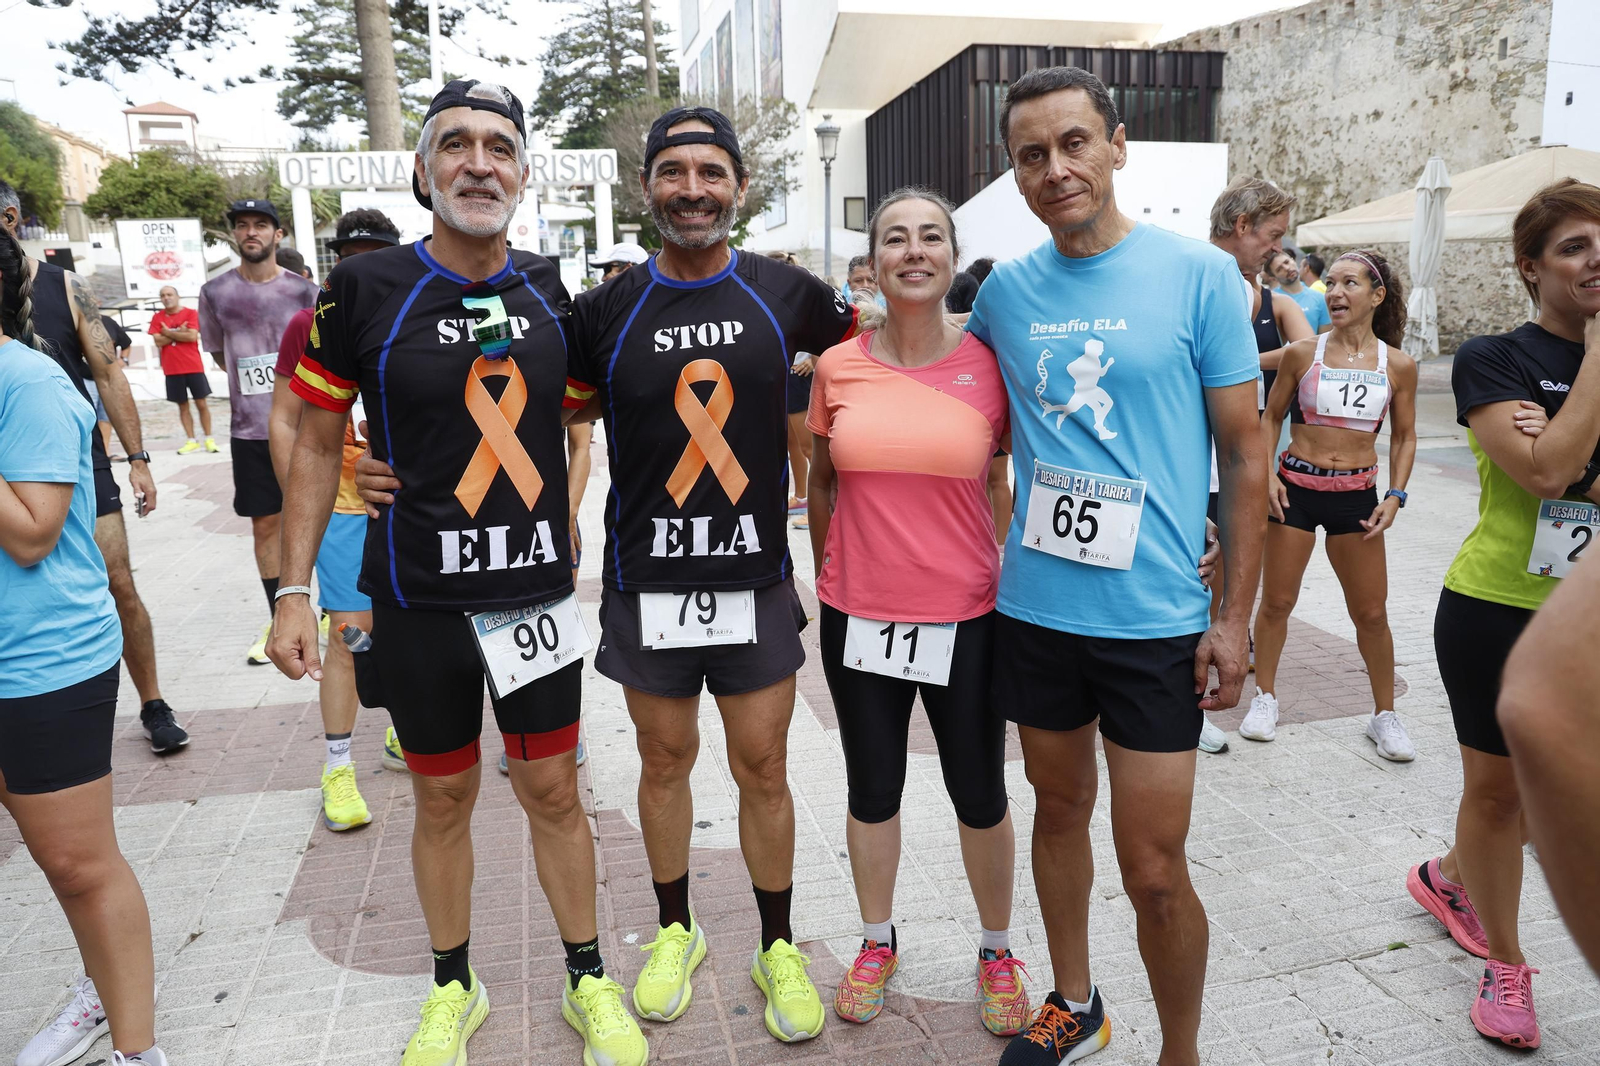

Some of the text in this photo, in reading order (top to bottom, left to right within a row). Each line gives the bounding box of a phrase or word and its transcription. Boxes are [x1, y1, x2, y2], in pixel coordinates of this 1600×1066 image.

[285, 153, 615, 186] OFICINA RISMO
[142, 222, 175, 235] OPEN
[653, 320, 744, 353] STOP
[1030, 318, 1128, 335] Desafío ELA
[244, 365, 276, 387] 130
[1350, 372, 1365, 383] ELA
[1338, 382, 1368, 409] 12
[1039, 469, 1132, 502] DESAFÍO ELA TARIFA
[1052, 494, 1102, 544] 65
[1548, 505, 1589, 521] DESAFÍO
[437, 519, 559, 574] ELA
[649, 513, 762, 558] ELA
[1086, 551, 1111, 561] TARIFA
[672, 591, 717, 627] 79
[513, 613, 560, 662] 90
[879, 621, 919, 664] 11
[909, 669, 930, 678] TARIFA
